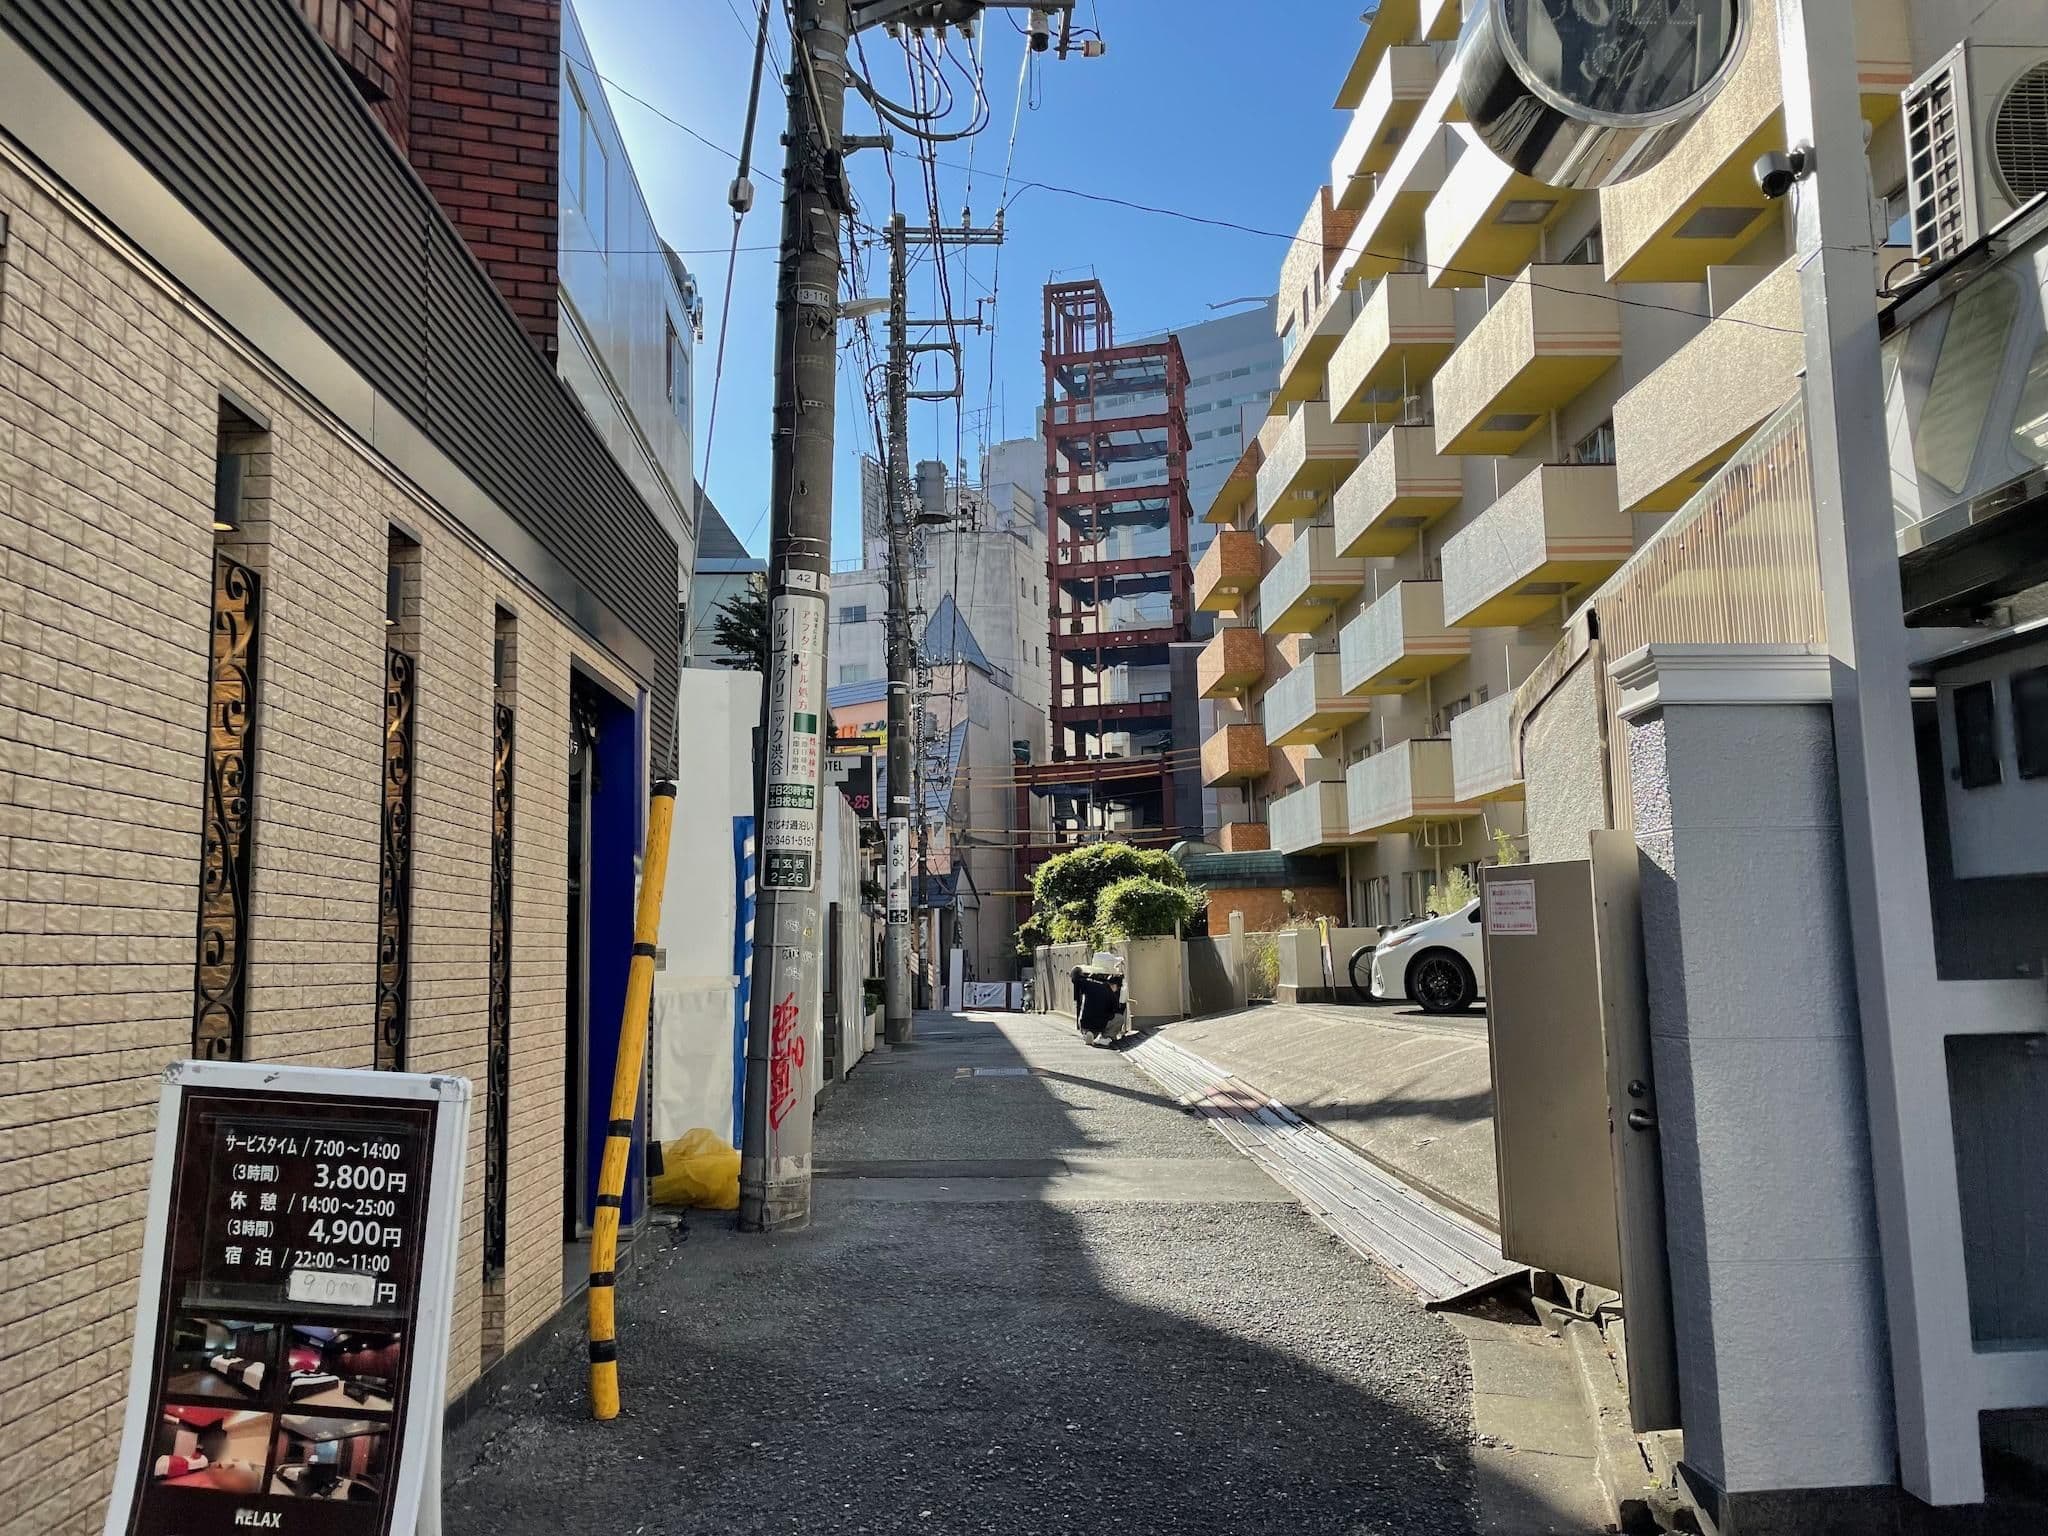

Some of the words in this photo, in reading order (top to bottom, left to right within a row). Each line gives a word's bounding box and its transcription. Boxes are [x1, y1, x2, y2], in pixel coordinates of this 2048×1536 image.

[796, 573, 811, 583] 42
[771, 608, 789, 776] アルファクリニック渋谷
[771, 872, 803, 883] 2-26
[226, 1135, 298, 1155] サービスタイム
[232, 1163, 280, 1183] (3時間)
[227, 1219, 274, 1238] (3時間)
[235, 1508, 282, 1528] RELAX
